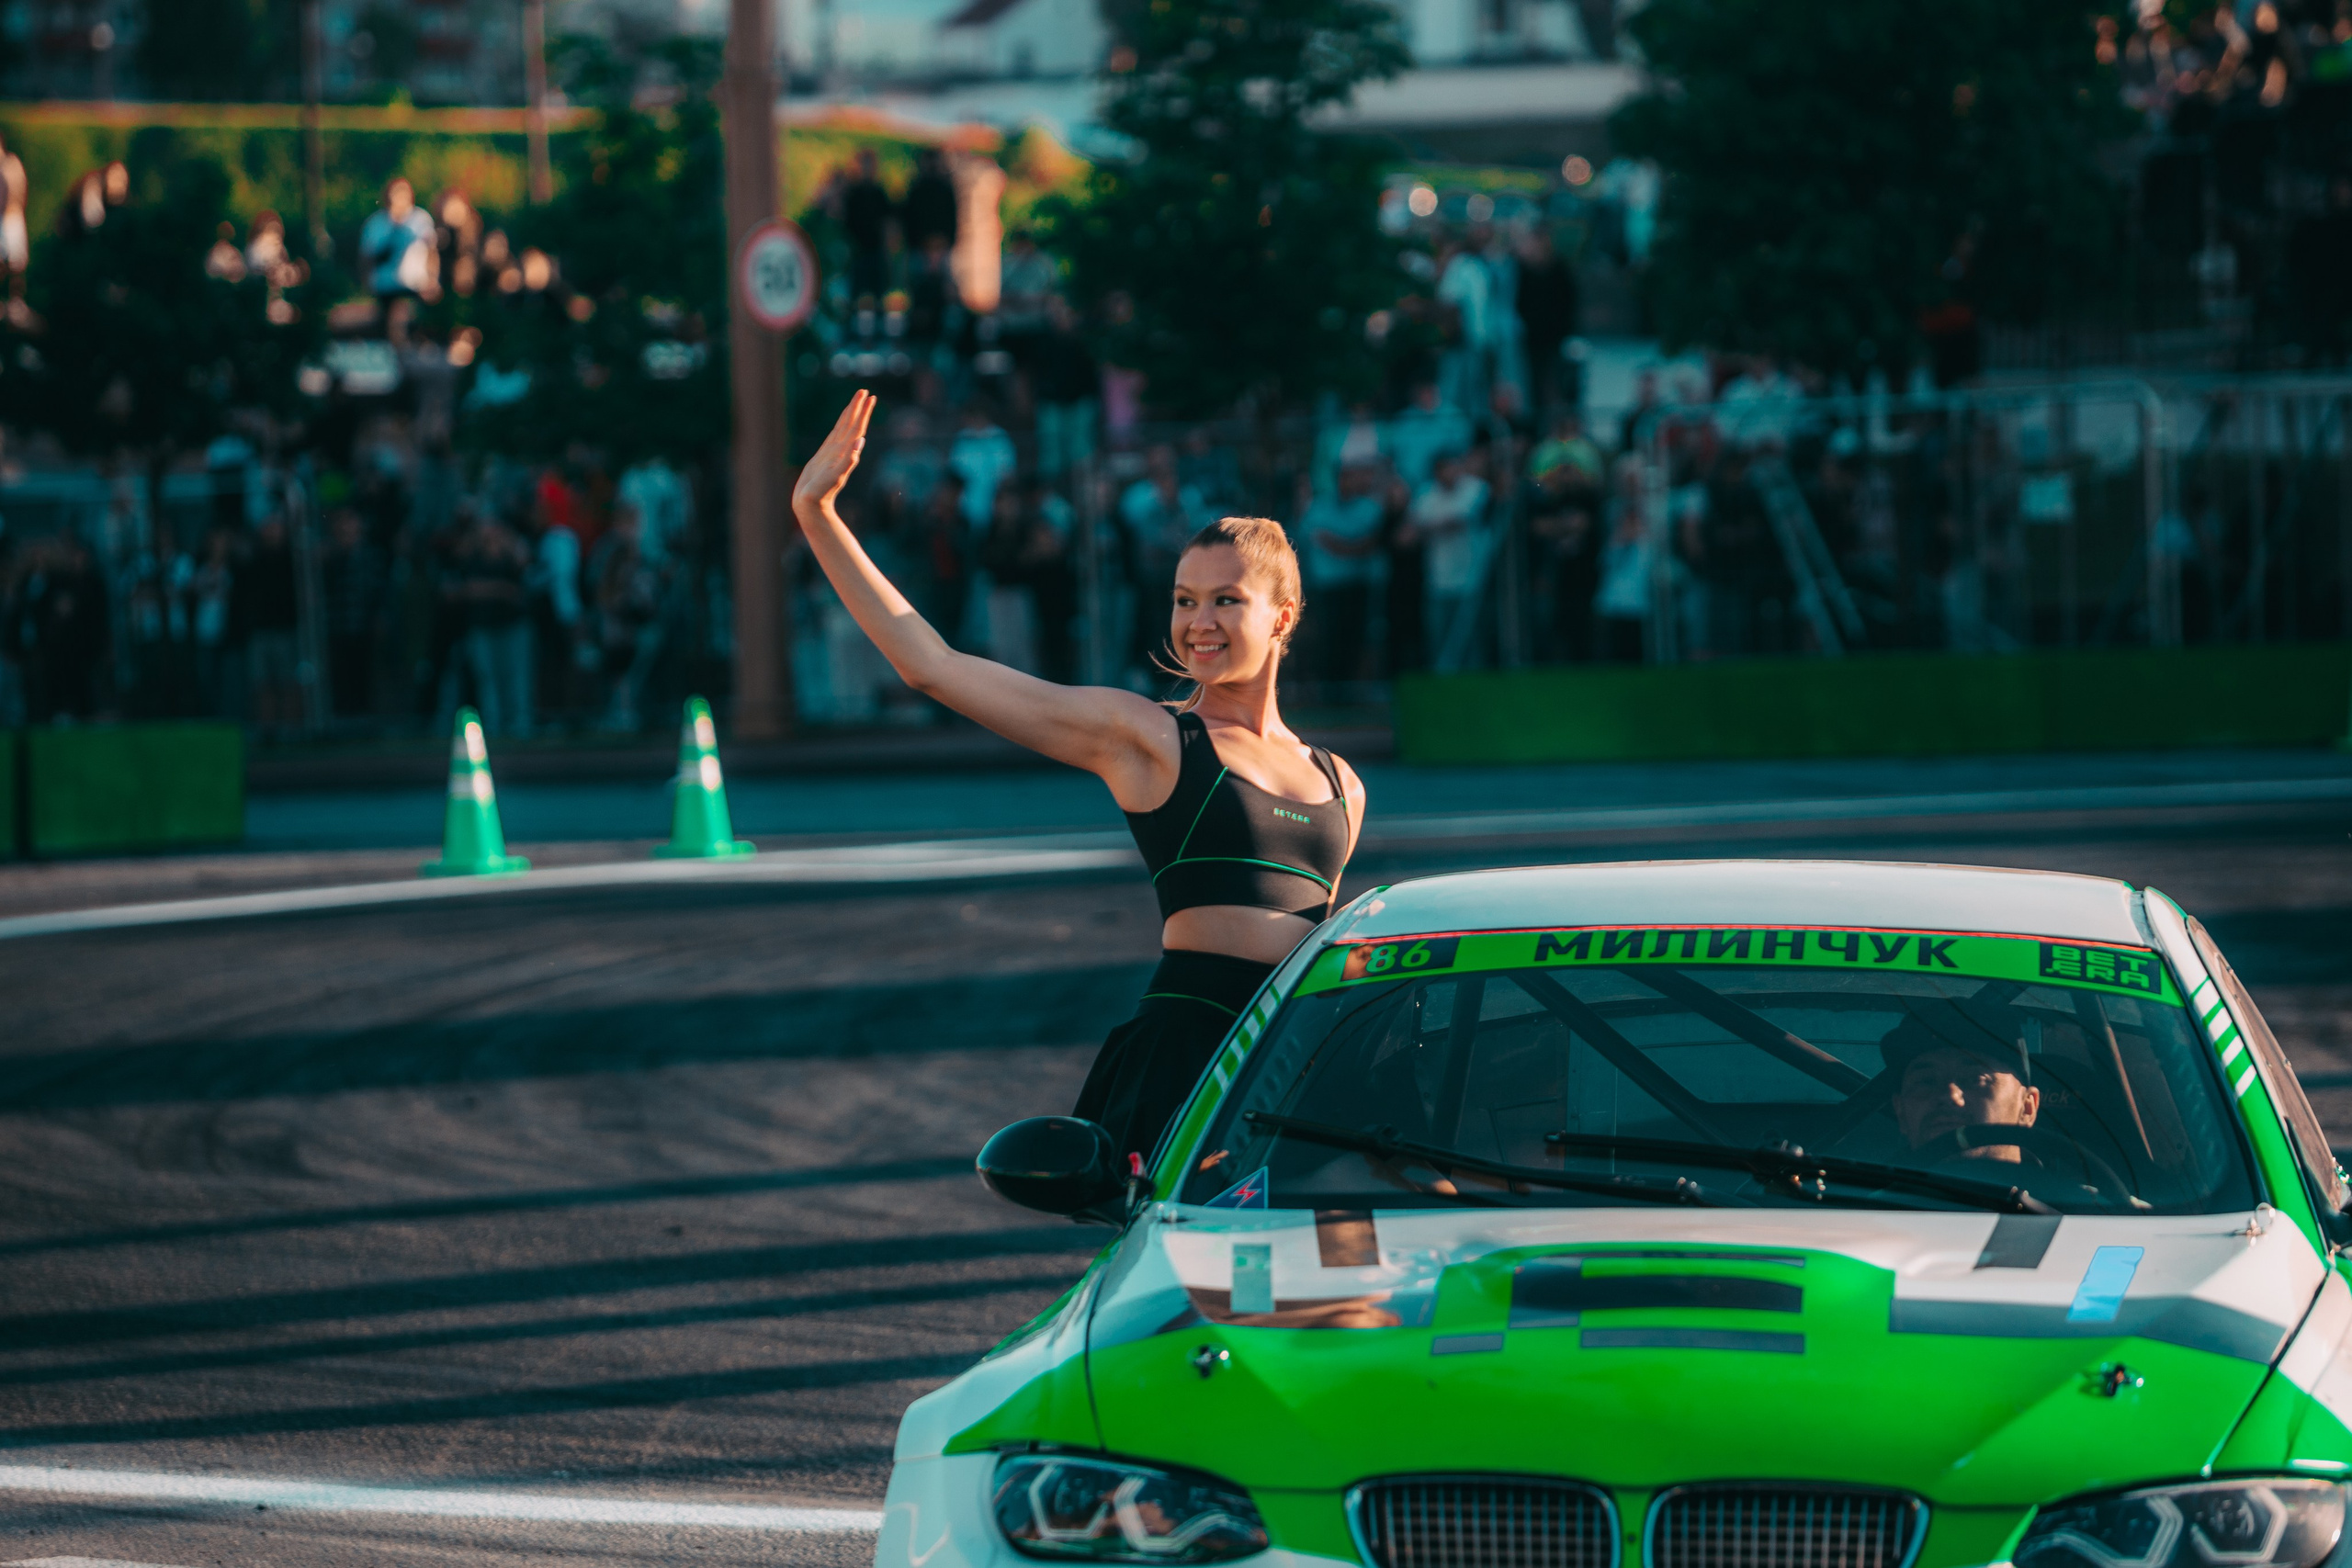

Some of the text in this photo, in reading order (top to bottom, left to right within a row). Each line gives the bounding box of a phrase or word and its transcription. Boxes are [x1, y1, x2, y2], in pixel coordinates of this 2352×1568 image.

[1365, 939, 1431, 973] 86
[1533, 930, 1960, 968] МИЛИНЧУК
[2052, 944, 2148, 972] BET
